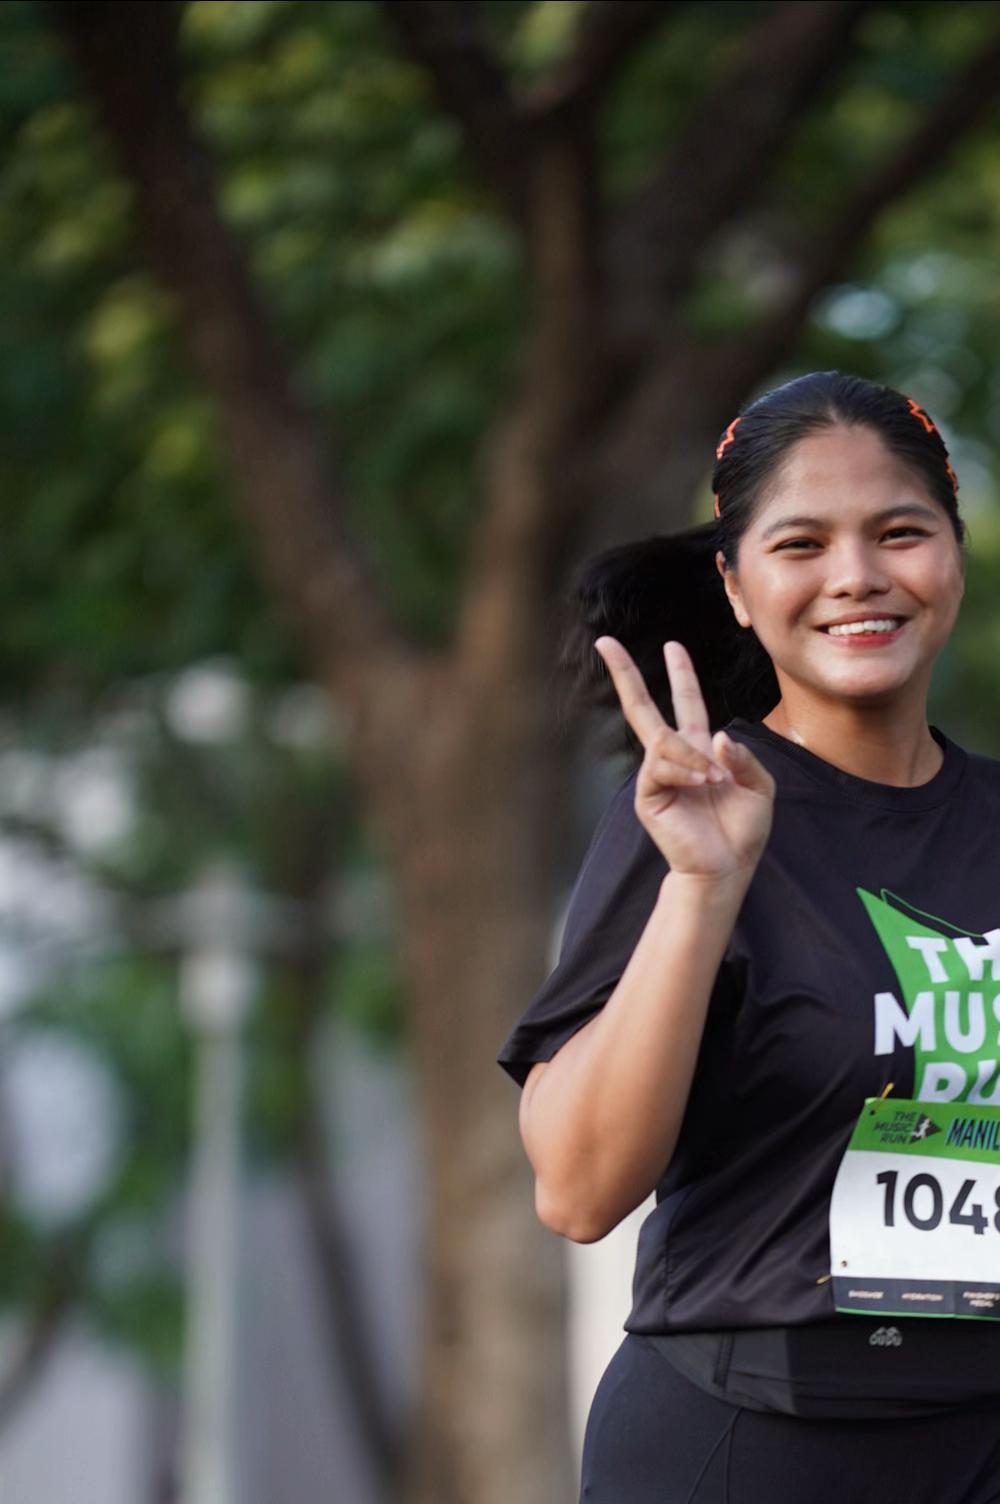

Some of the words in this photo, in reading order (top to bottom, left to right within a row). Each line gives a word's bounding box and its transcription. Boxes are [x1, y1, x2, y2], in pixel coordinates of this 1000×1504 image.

[894, 1111, 917, 1122] THE
[874, 1121, 913, 1133] MUSIC
[880, 1132, 908, 1145] RUN
